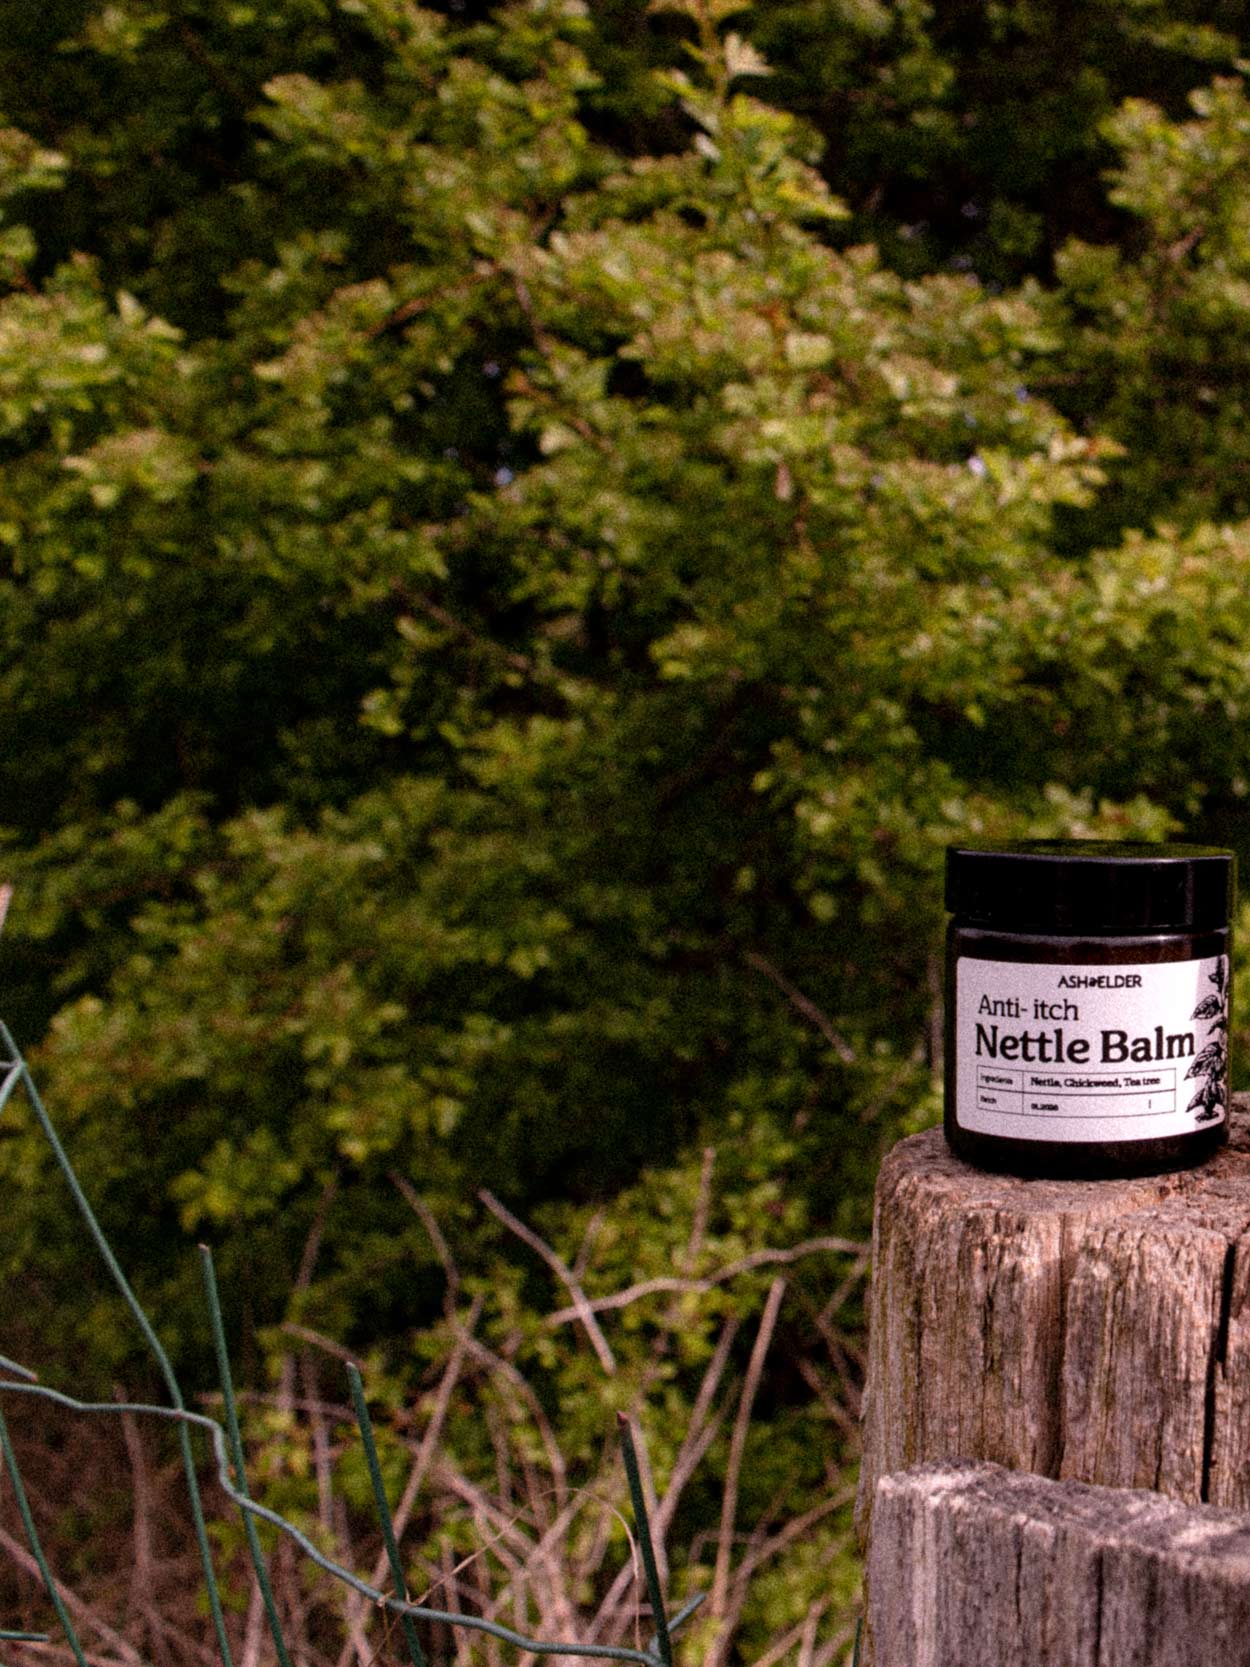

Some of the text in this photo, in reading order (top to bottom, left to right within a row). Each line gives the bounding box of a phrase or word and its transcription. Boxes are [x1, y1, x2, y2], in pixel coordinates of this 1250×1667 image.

[978, 994, 1079, 1021] Anti- itch
[975, 1023, 1195, 1064] Nettle Balm
[1031, 1077, 1062, 1088] Nettle,
[1124, 1077, 1142, 1087] Tea
[1142, 1076, 1161, 1086] tree
